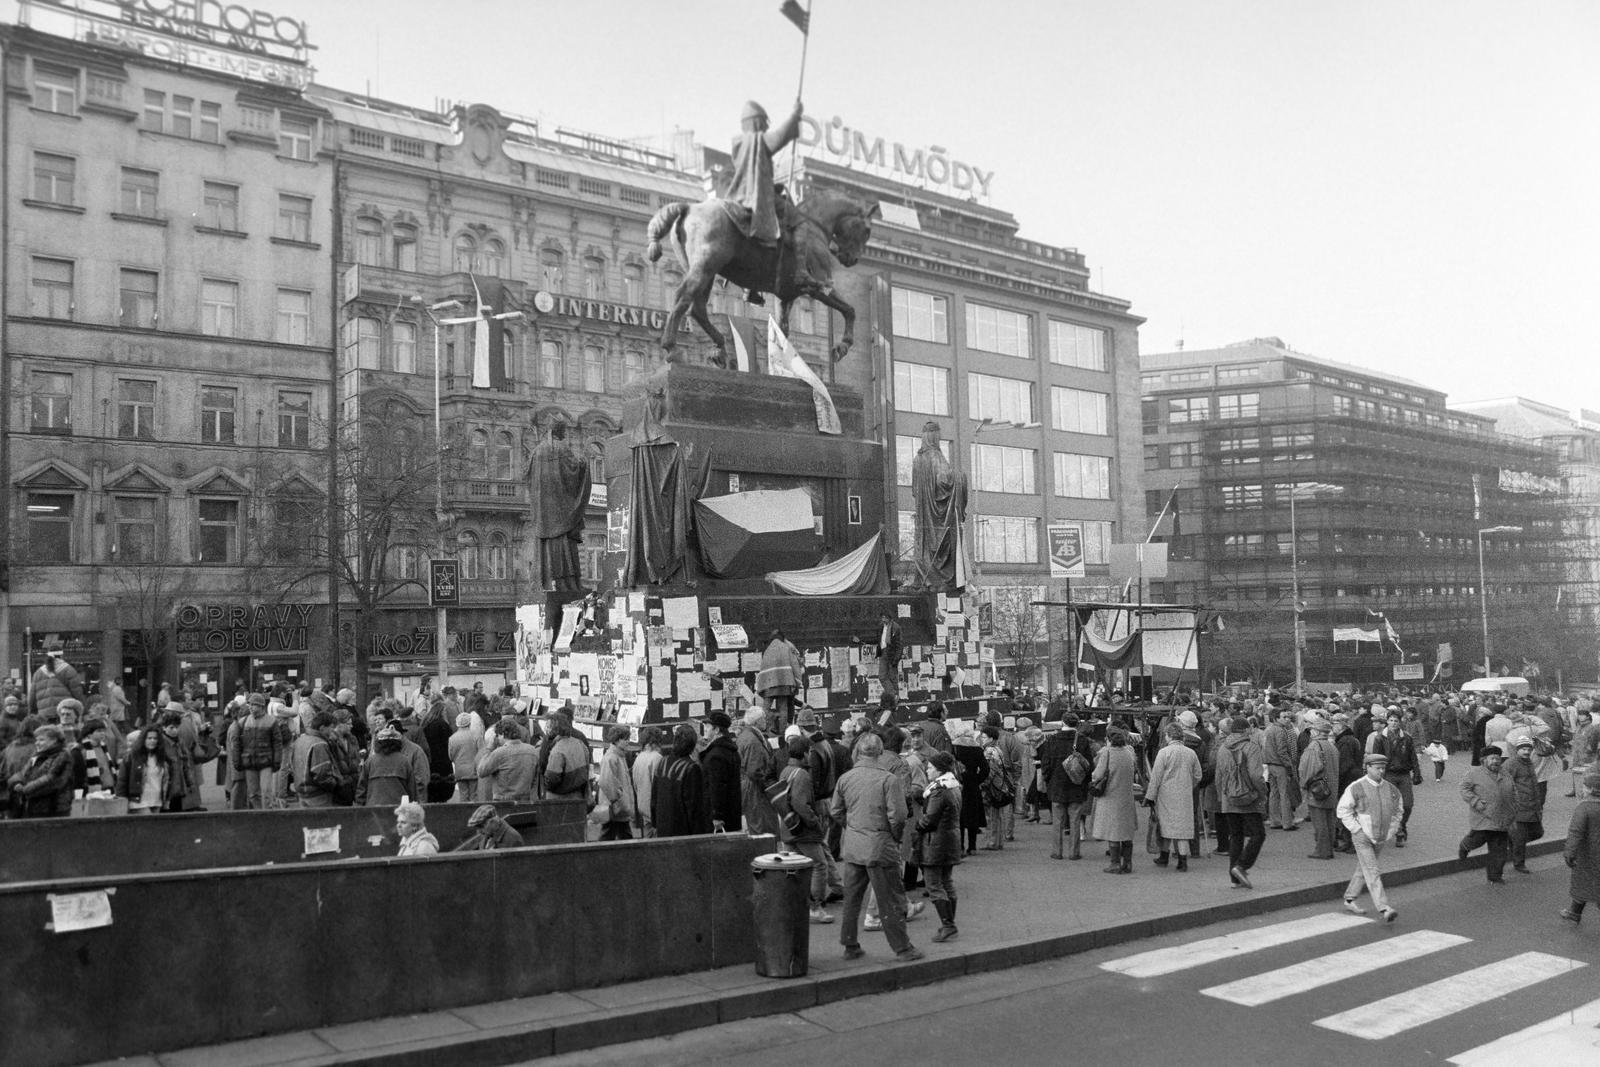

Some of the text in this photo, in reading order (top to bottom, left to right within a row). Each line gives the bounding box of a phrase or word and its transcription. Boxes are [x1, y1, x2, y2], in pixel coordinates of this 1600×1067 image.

[799, 115, 885, 168] DŮM
[558, 297, 693, 333] INTERSIGA
[177, 604, 315, 628] OPRAVY
[205, 628, 306, 652] OBUVI
[372, 625, 486, 657] KOŽNÉ
